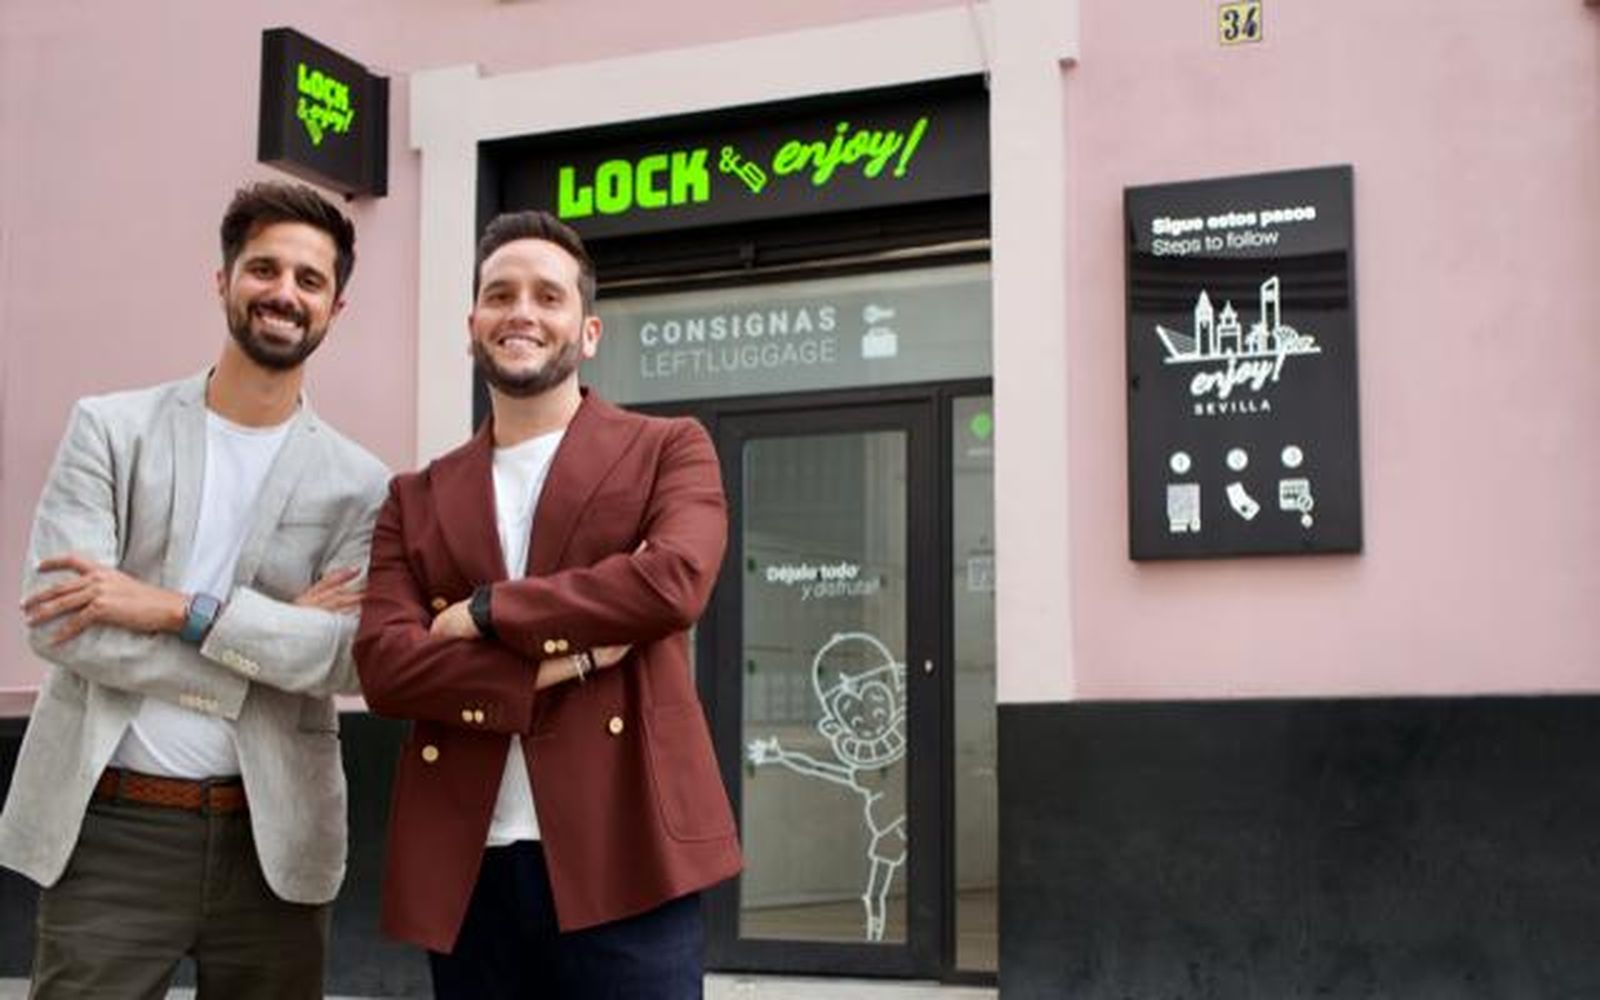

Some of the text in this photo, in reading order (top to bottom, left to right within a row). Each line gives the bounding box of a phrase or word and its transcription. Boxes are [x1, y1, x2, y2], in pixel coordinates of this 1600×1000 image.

[1223, 6, 1257, 41] 34
[298, 63, 349, 112] LOCK
[558, 149, 710, 218] LOCK
[772, 117, 928, 186] enjoy!
[1152, 206, 1317, 237] Sigue estos pasos
[1152, 230, 1280, 257] Steps to follow
[640, 305, 837, 346] CONSIGNAS
[1194, 400, 1272, 416] SEVILLA
[820, 560, 859, 580] todo
